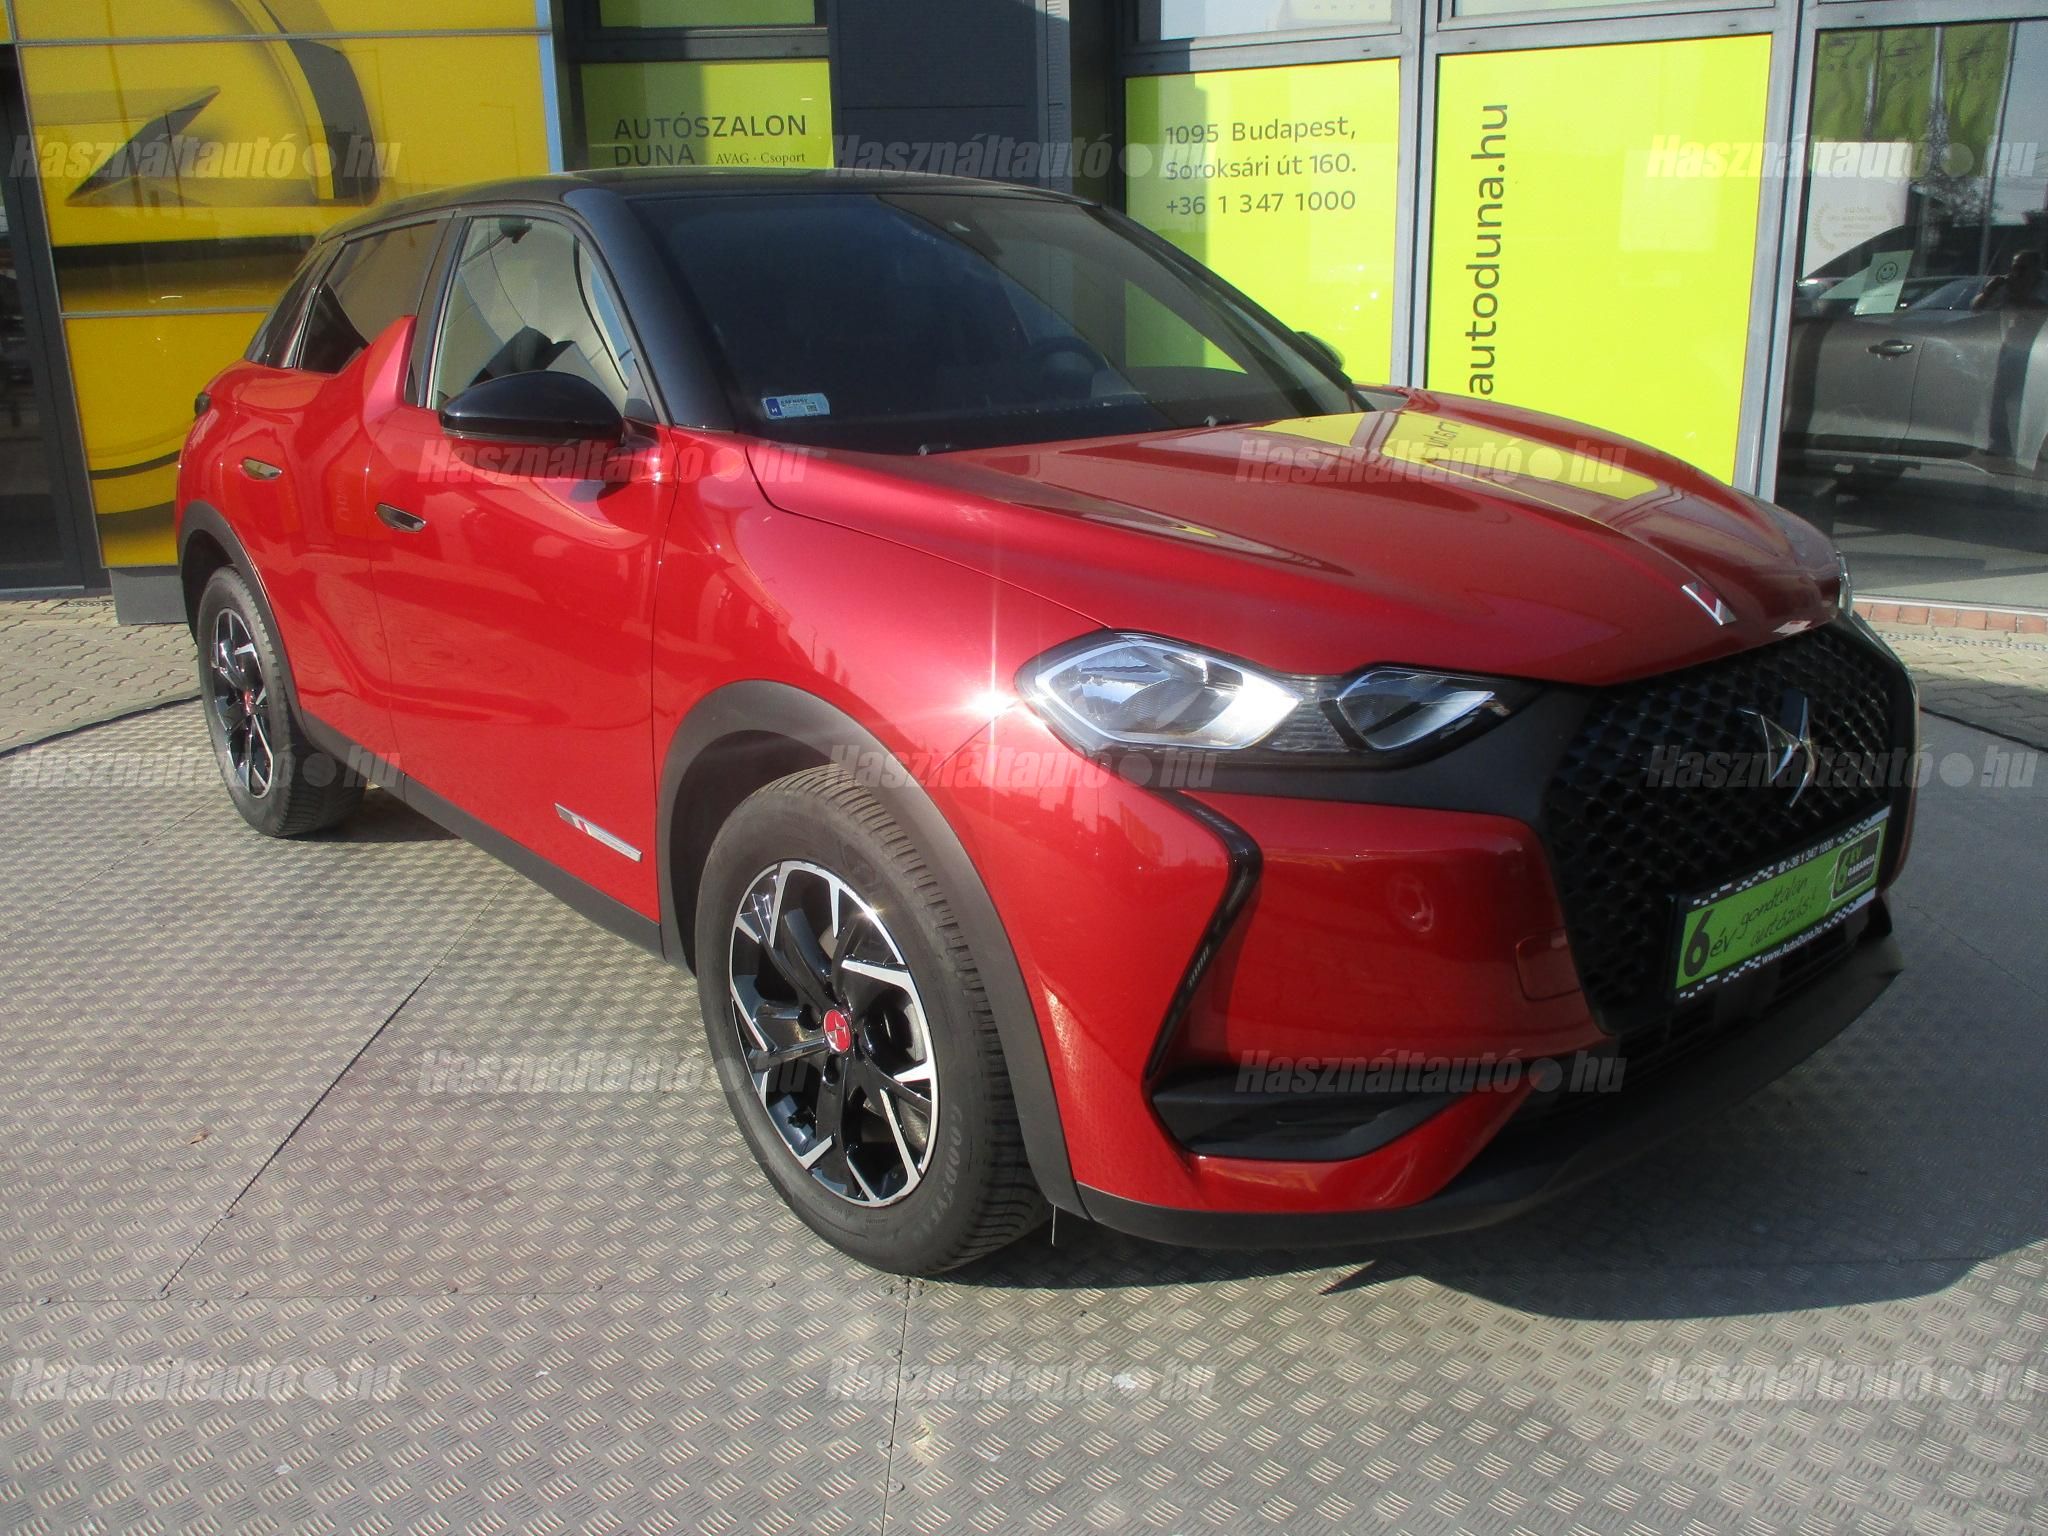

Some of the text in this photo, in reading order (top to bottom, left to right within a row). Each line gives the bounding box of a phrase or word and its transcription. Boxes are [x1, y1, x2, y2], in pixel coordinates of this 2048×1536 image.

[614, 111, 806, 140] AUTÓSZALON
[1165, 116, 1356, 144] 1095 Budapest,
[614, 143, 696, 166] DUNA
[716, 151, 806, 166] AVAG Csoport
[1166, 153, 1357, 181] Soroksári út 160.
[1166, 190, 1356, 215] +36 1 347 1000
[1465, 103, 1509, 395] autoduna.hu
[1683, 908, 1715, 977] 6
[1710, 927, 1738, 957] év
